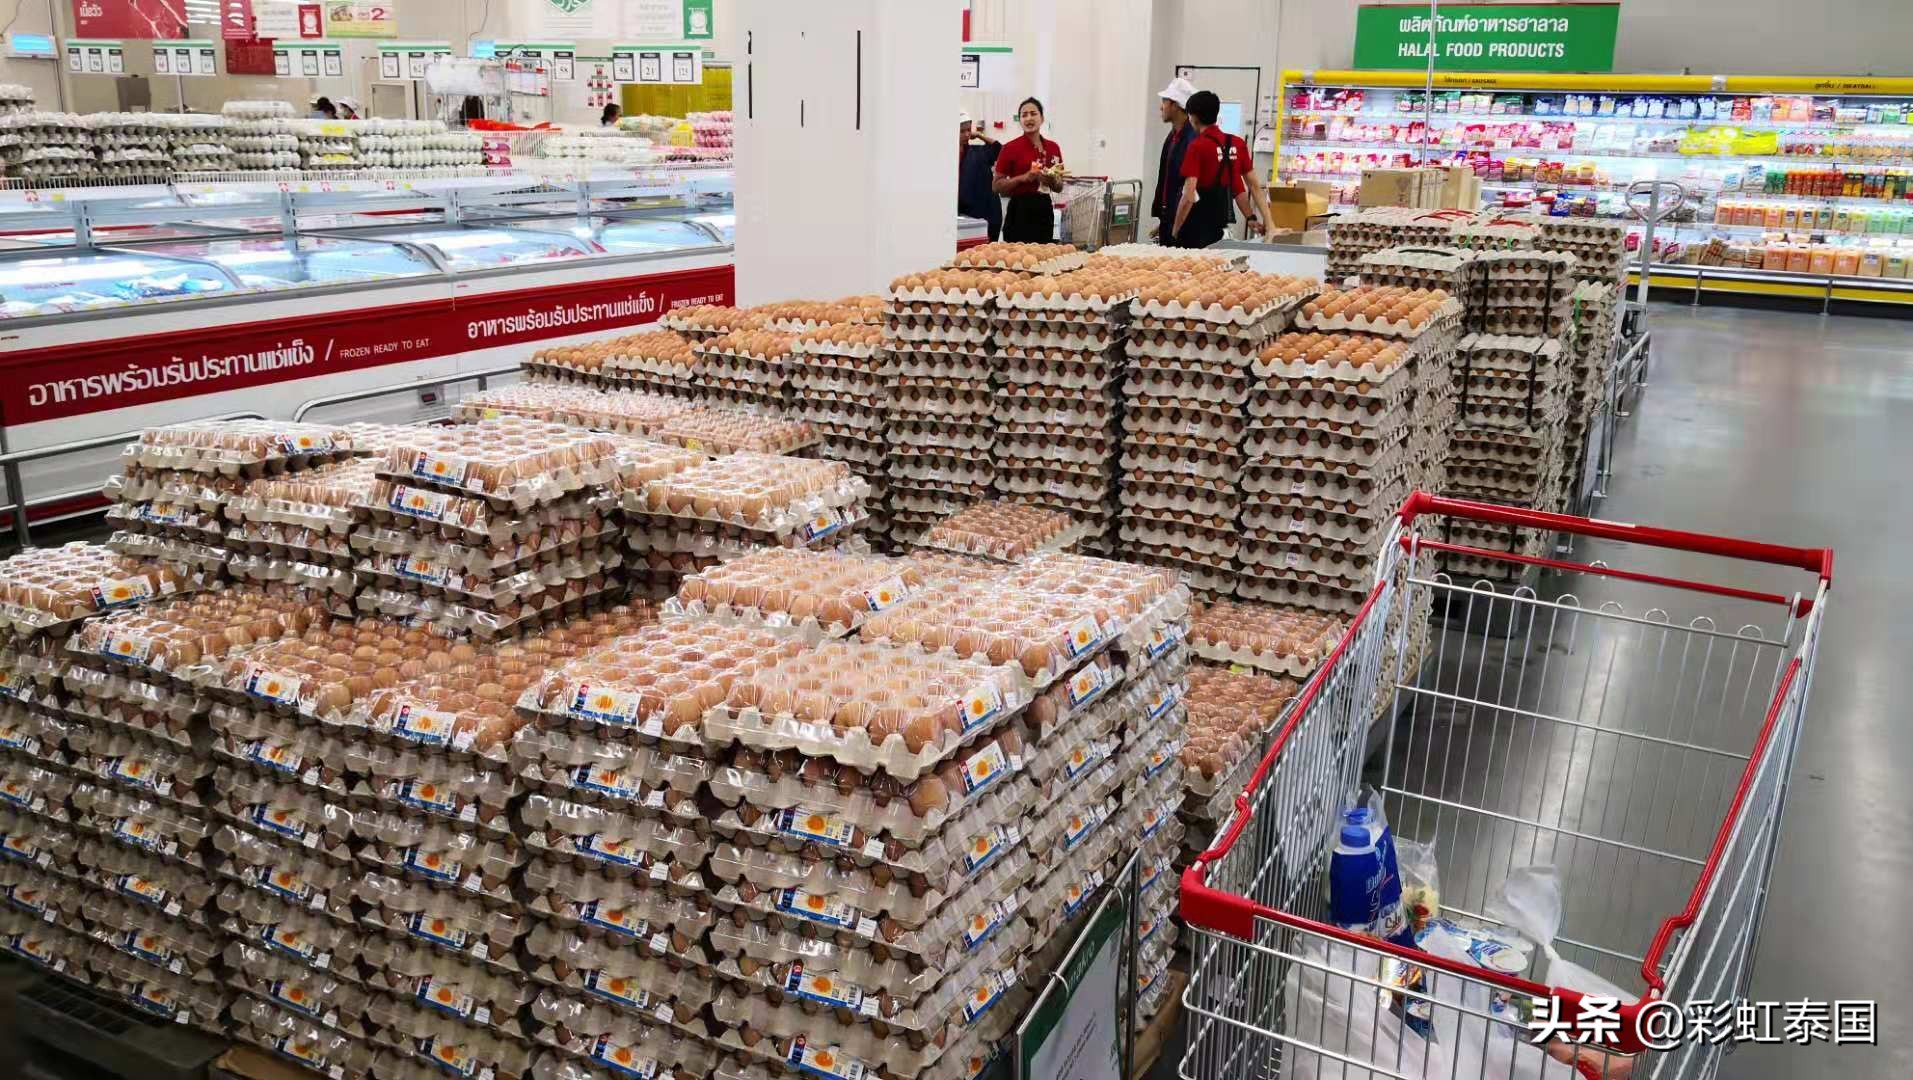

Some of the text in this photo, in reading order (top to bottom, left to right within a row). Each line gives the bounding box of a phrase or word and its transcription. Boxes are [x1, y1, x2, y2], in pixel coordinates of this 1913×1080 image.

[1398, 42, 1565, 58] HALAL FOOD PRODUCTS
[467, 291, 655, 339] อาหารพร้อมรับประทานแช่แข็ง
[29, 338, 314, 406] อาหารพร้อมรับประทานแช่แข็ง
[339, 346, 371, 359] FROZEN
[373, 341, 400, 355] READY
[402, 339, 414, 350] TO
[415, 337, 430, 349] EAT
